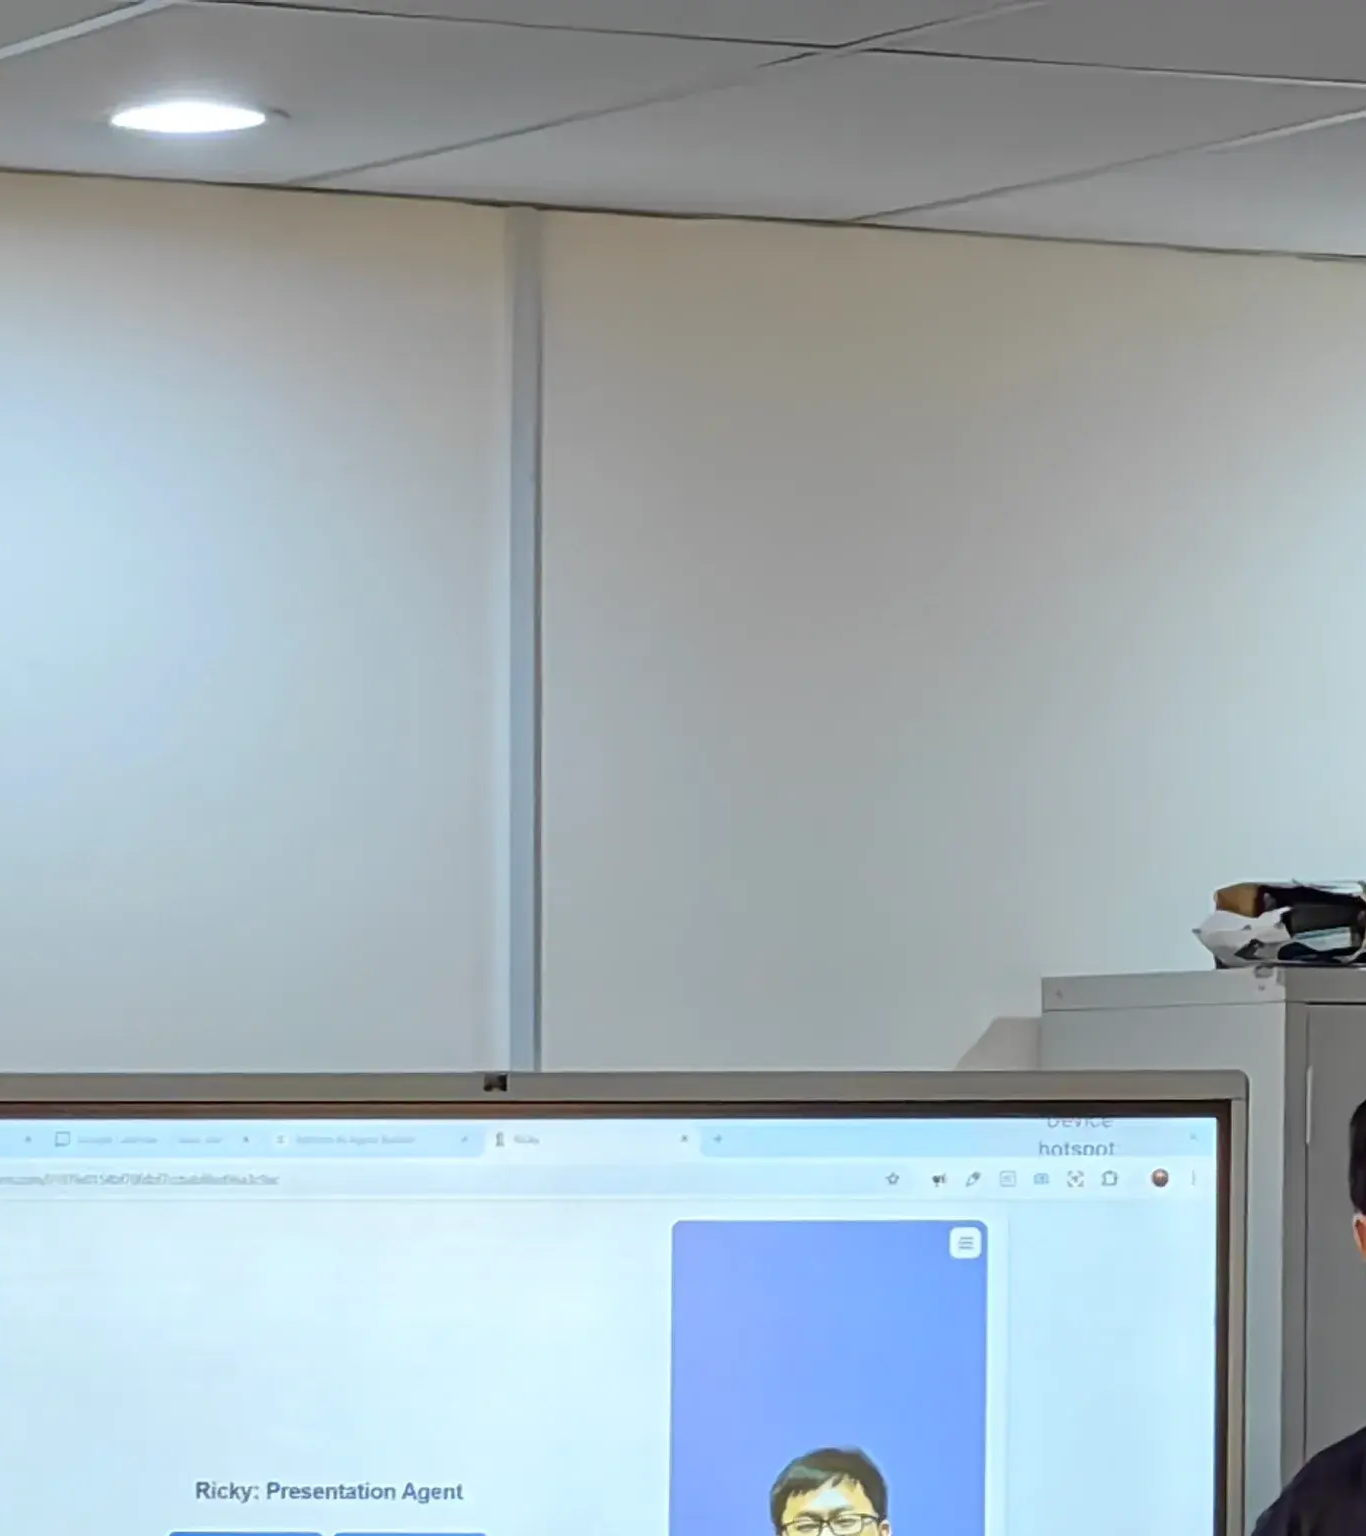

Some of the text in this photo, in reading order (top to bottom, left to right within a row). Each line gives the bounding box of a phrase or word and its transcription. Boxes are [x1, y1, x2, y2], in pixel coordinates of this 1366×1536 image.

[194, 1481, 464, 1504] Ricky: Presentation Agent
